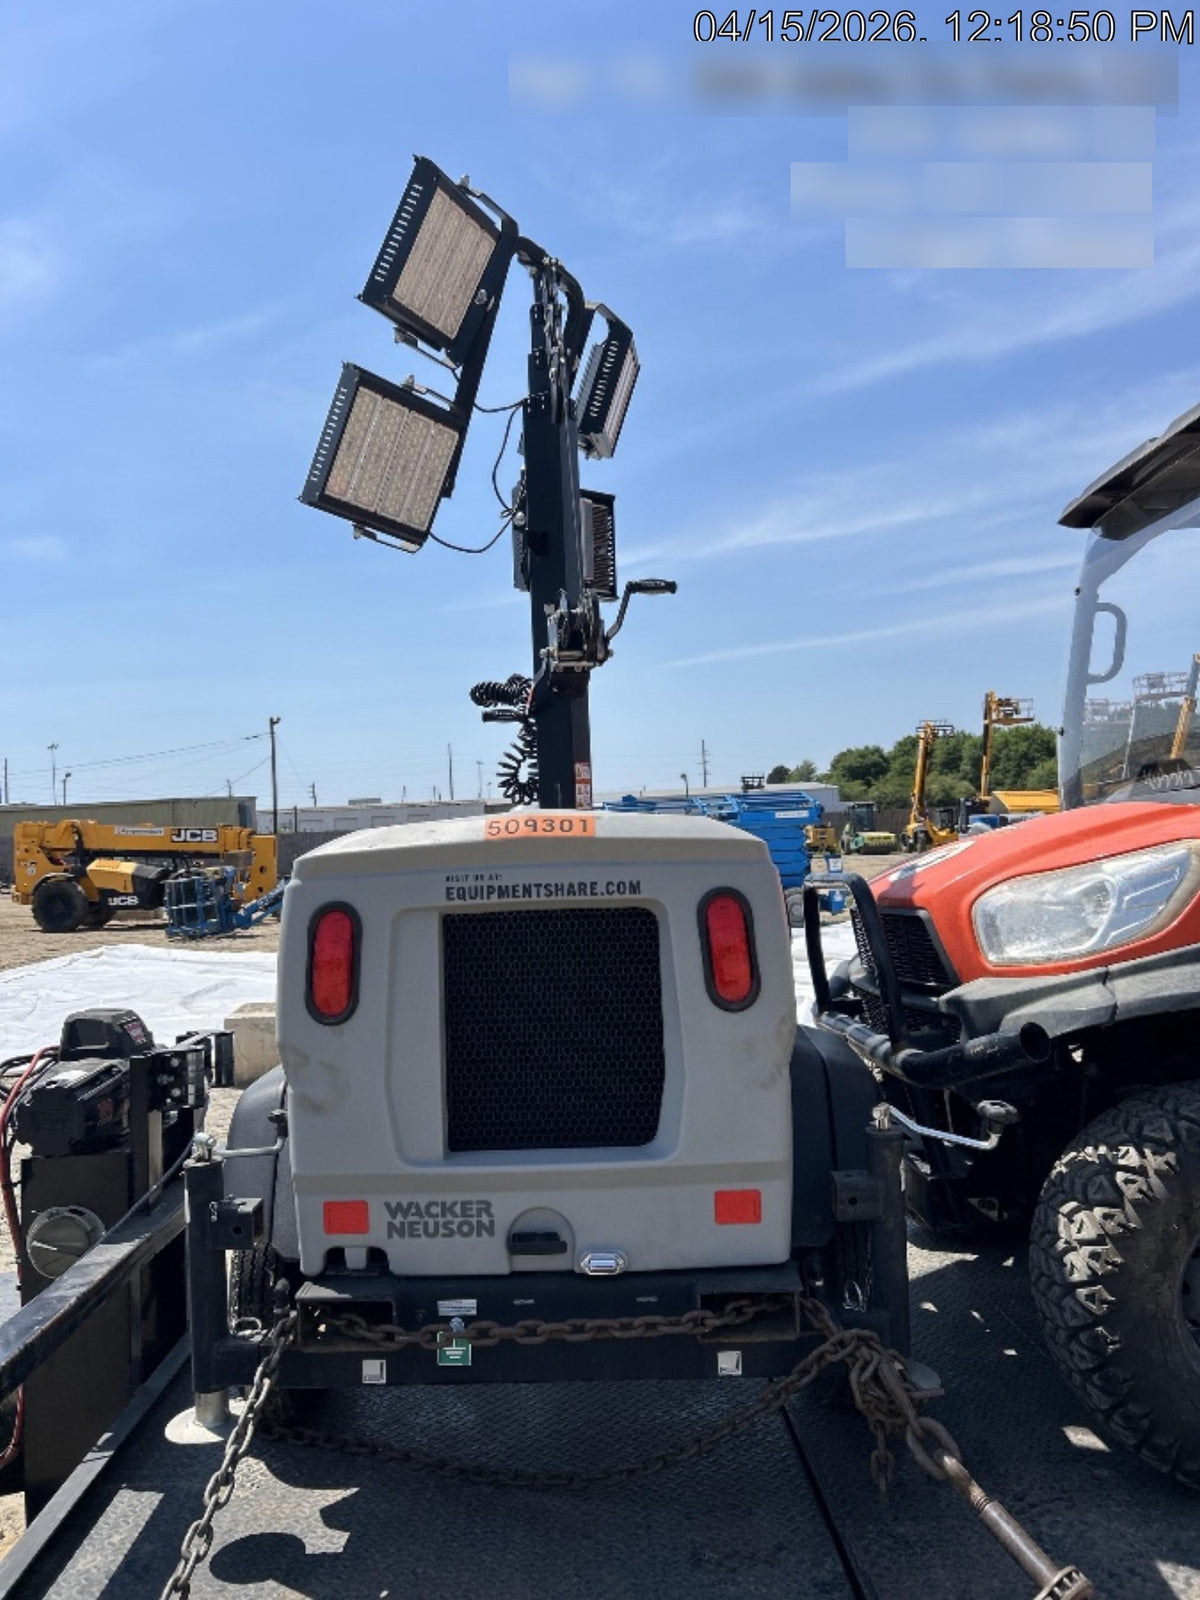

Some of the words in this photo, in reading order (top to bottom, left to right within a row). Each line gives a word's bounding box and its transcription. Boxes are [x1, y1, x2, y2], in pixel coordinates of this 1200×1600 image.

[172, 829, 217, 842] JCB
[488, 818, 589, 836] 509301
[445, 880, 642, 901] EQUIPMENTSHARE.COM
[108, 895, 139, 906] JCB
[383, 1200, 495, 1220] WACKER
[387, 1219, 495, 1239] NEUSON
